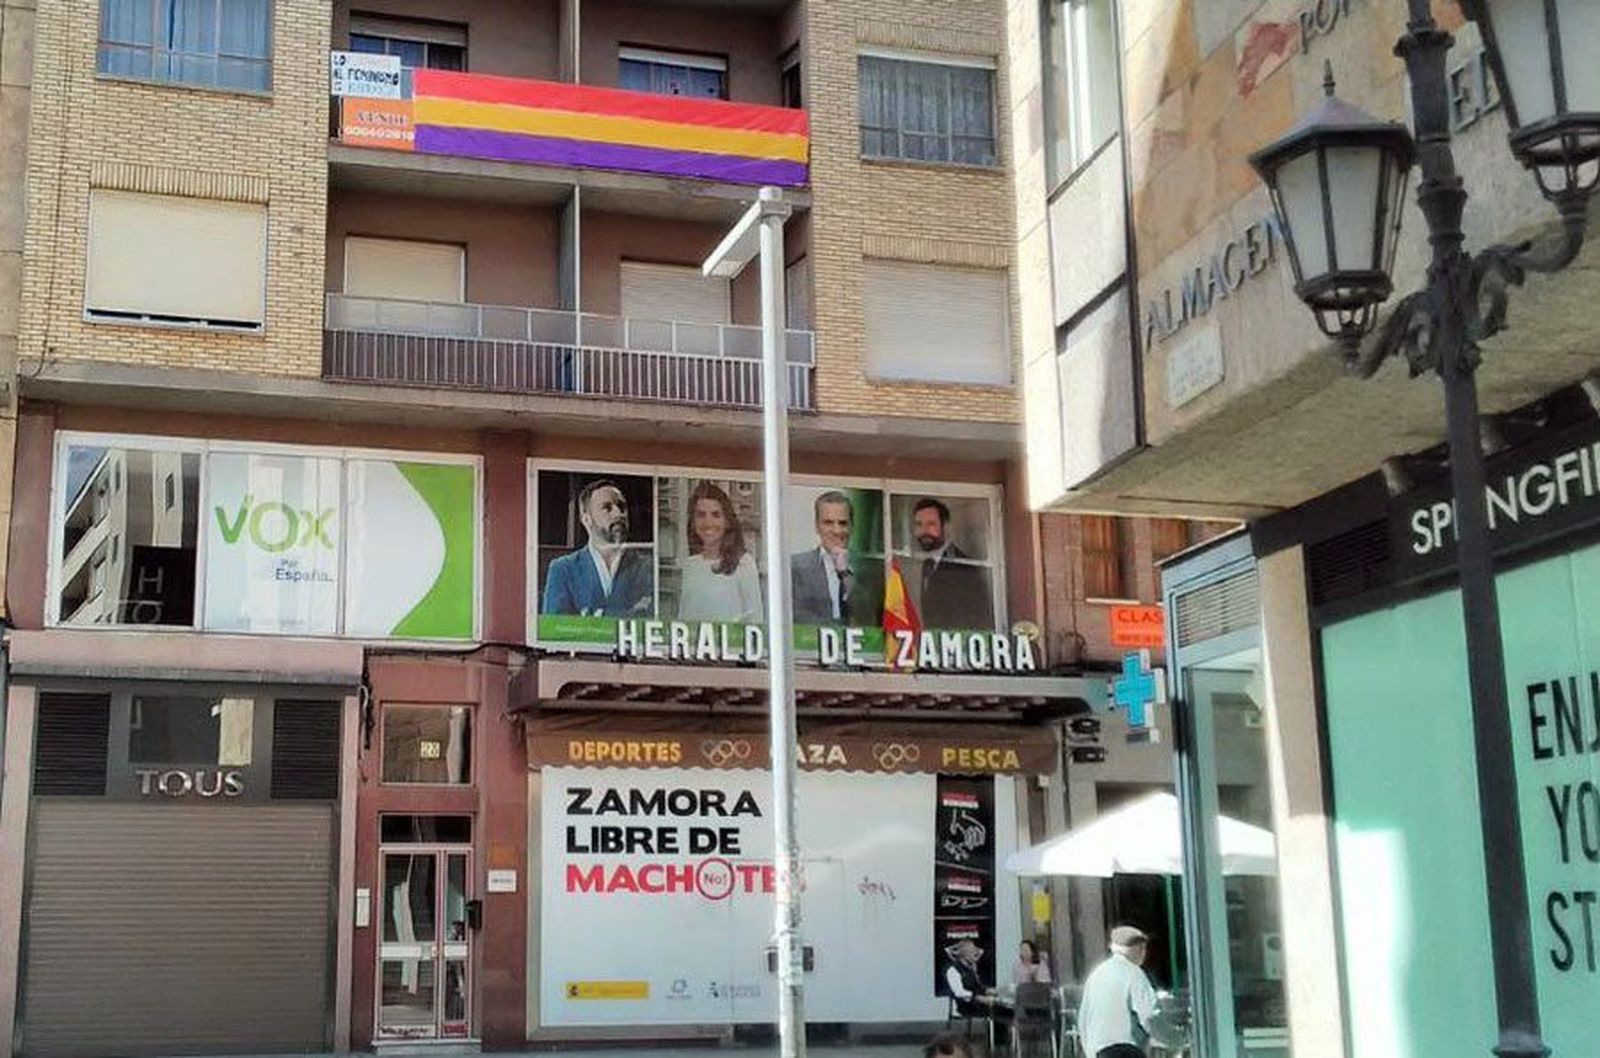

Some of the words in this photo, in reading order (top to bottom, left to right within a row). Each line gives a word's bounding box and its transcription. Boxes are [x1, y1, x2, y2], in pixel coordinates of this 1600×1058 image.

[1300, 0, 1350, 55] PO
[1411, 441, 1600, 554] SPNGFI
[215, 495, 336, 553] VOX
[618, 619, 766, 663] HERALD
[819, 626, 867, 666] DE
[896, 629, 1036, 672] ZAMORA
[568, 740, 682, 762] DEPORTES
[942, 747, 1021, 769] PESCA
[135, 770, 244, 796] TOUS
[566, 787, 762, 817] ZAMORA
[566, 826, 679, 854] LIBRE
[689, 826, 741, 855] DE
